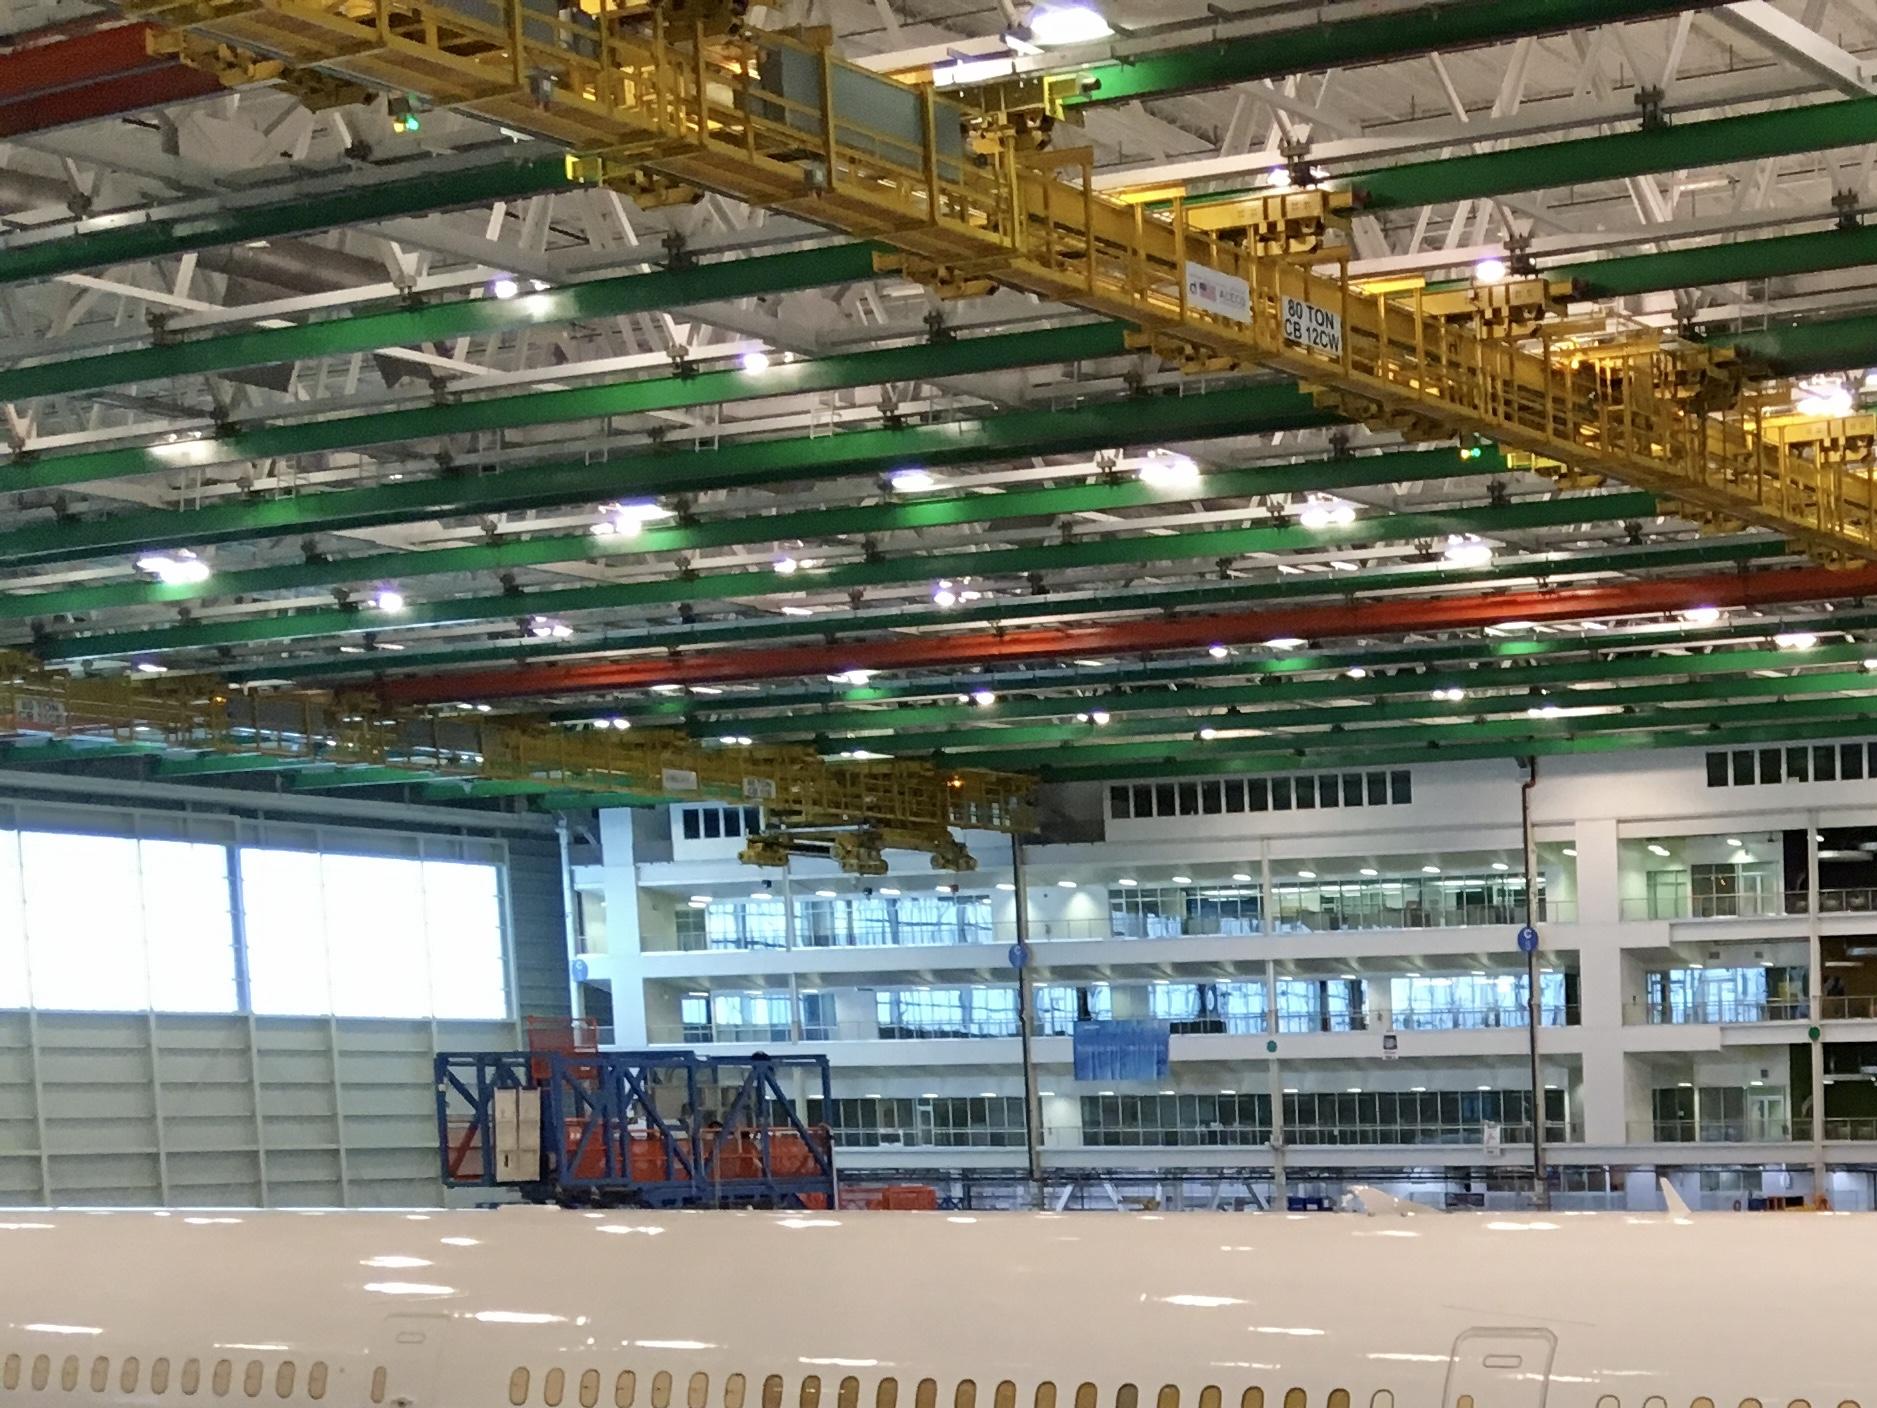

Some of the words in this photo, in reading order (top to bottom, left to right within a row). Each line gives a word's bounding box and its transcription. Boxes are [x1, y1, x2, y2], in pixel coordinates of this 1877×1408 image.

[1288, 299, 1303, 320] 80
[1306, 305, 1335, 330] TON
[1285, 318, 1302, 340] CB
[1306, 327, 1340, 352] 12CW
[1523, 928, 1533, 939] C
